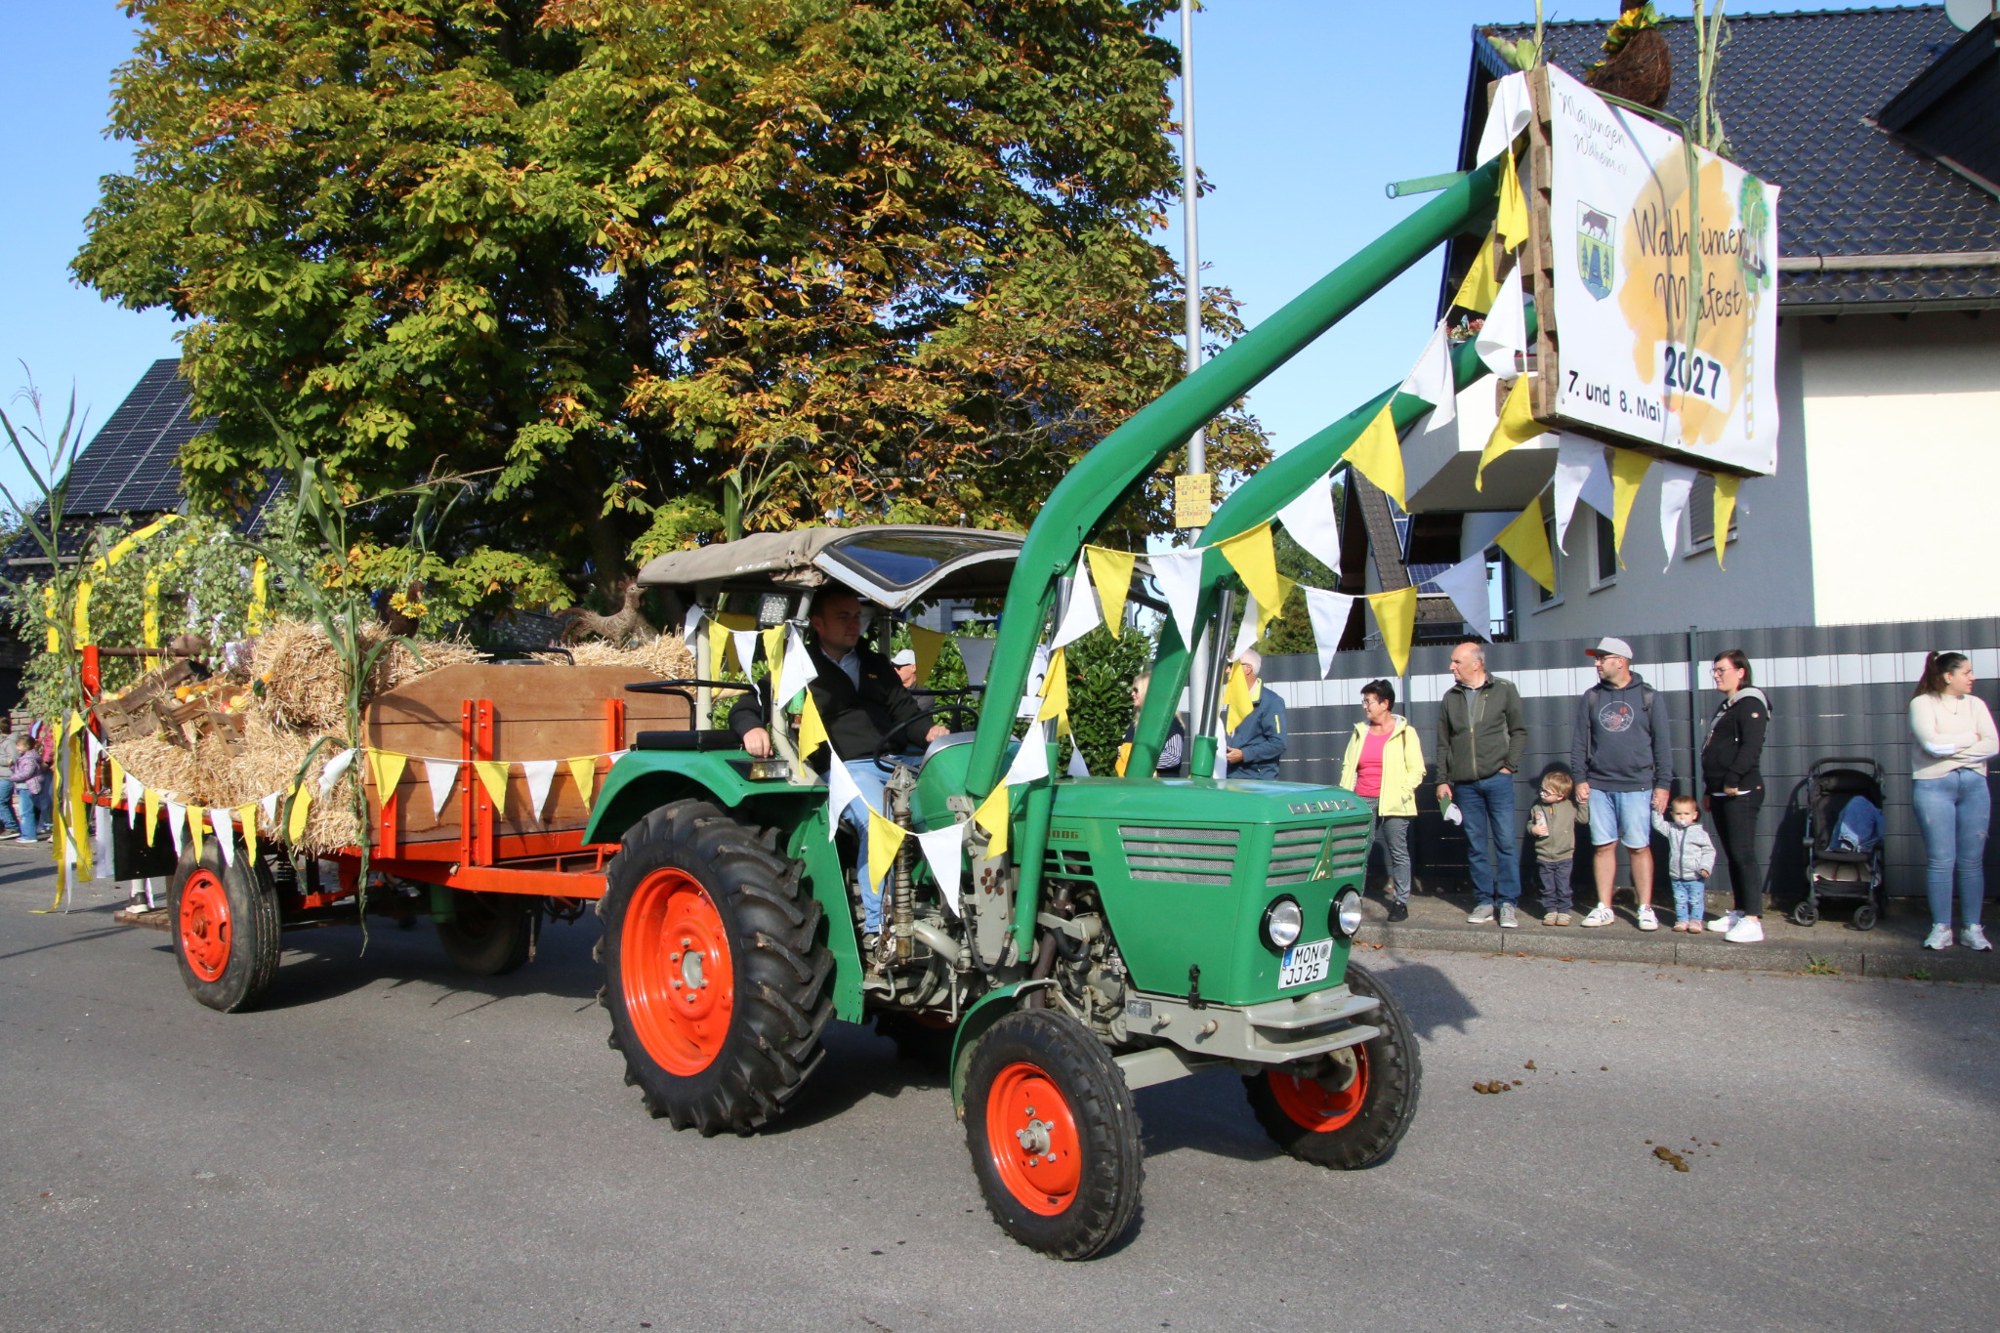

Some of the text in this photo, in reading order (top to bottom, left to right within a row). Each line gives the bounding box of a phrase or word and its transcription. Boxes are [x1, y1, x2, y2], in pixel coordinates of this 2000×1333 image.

[1633, 202, 1747, 257] Walhimer
[1664, 346, 1721, 400] 2027
[1568, 369, 1661, 422] 7. und 8. Mai
[1288, 799, 1357, 815] DEUTZ
[1294, 945, 1319, 965] MON
[1286, 963, 1320, 985] JJ 25
